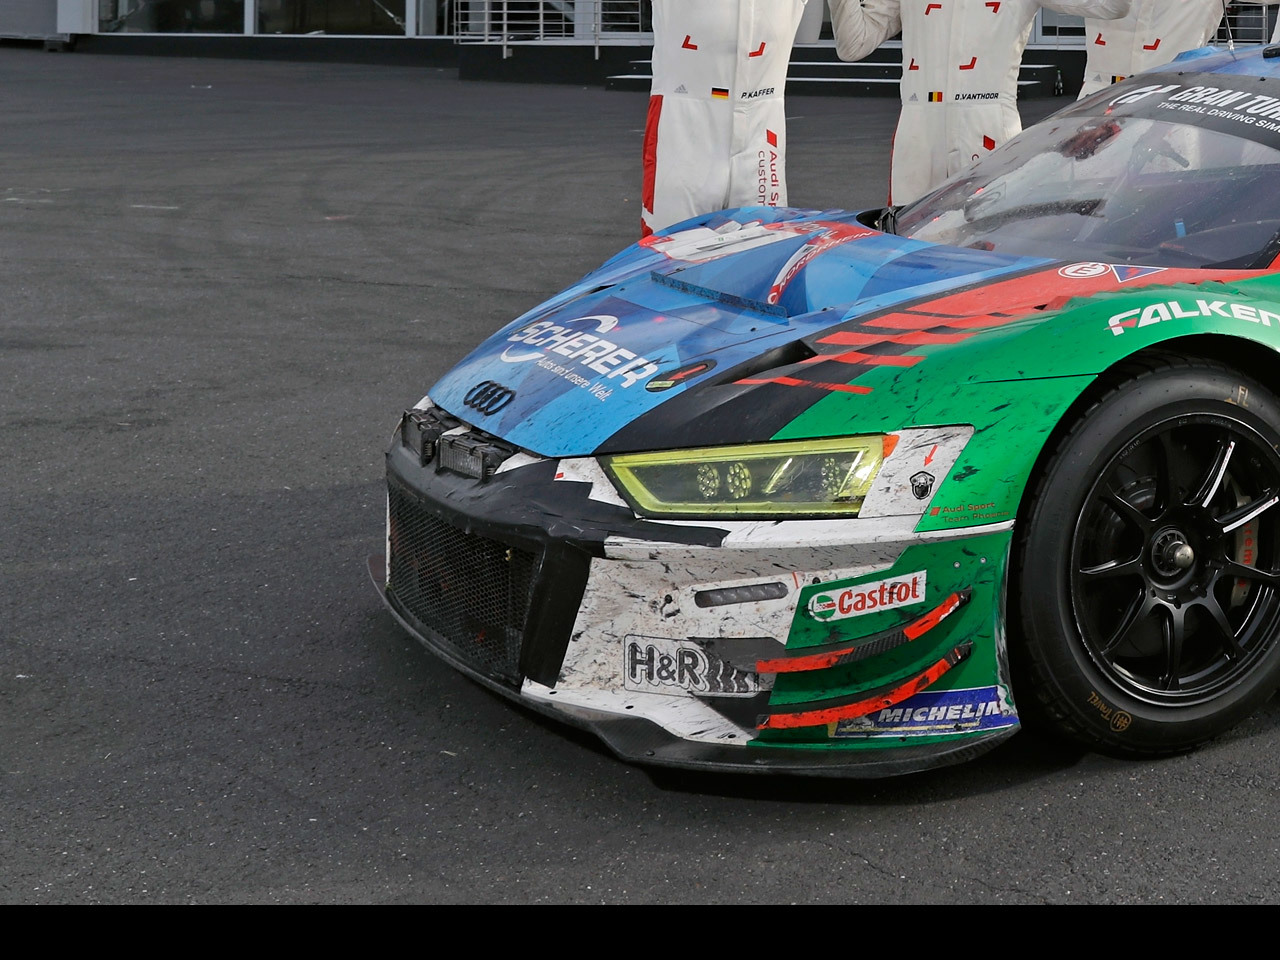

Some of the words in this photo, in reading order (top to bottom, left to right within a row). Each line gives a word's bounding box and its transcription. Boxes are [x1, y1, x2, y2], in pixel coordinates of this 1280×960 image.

[741, 87, 775, 99] P.KAFFER
[1168, 86, 1239, 108] GRAN
[1157, 101, 1174, 111] THE
[1175, 103, 1205, 114] REAL
[1207, 108, 1254, 125] DRIVING
[770, 150, 780, 187] Audi
[507, 321, 658, 388] SCHERER
[839, 576, 920, 614] Castrol
[628, 642, 701, 687] H&R
